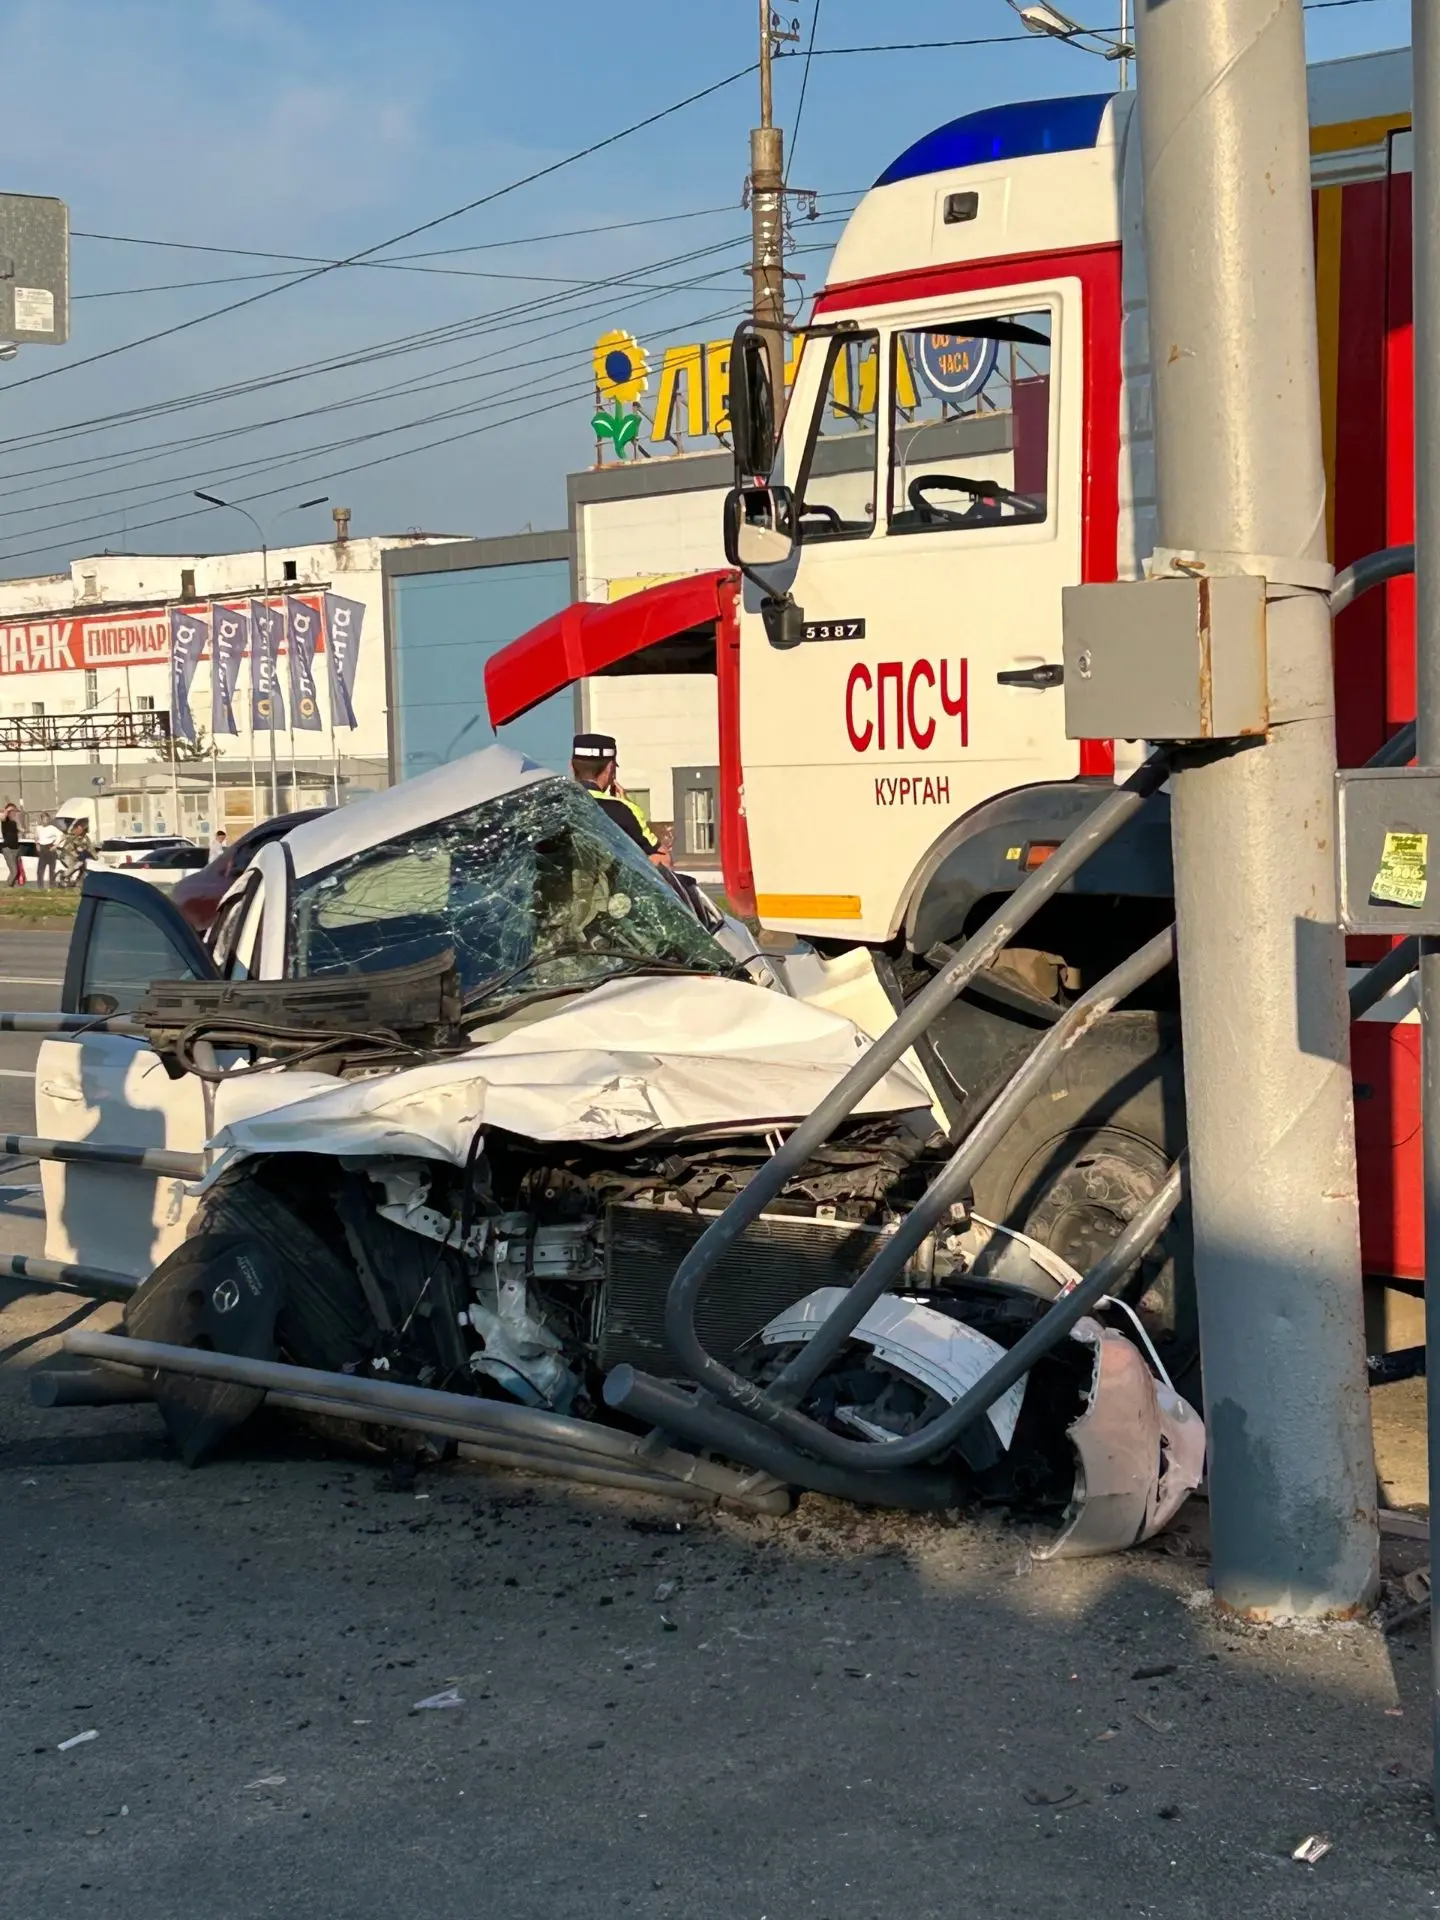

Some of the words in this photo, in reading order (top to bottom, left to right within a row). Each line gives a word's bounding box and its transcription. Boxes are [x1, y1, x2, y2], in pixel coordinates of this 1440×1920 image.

[938, 351, 970, 376] ЧАСА
[87, 623, 171, 657] ГИПЕРМАР
[806, 624, 858, 640] 5387
[845, 657, 968, 752] СПСЧ
[874, 775, 950, 805] КУРГАН
